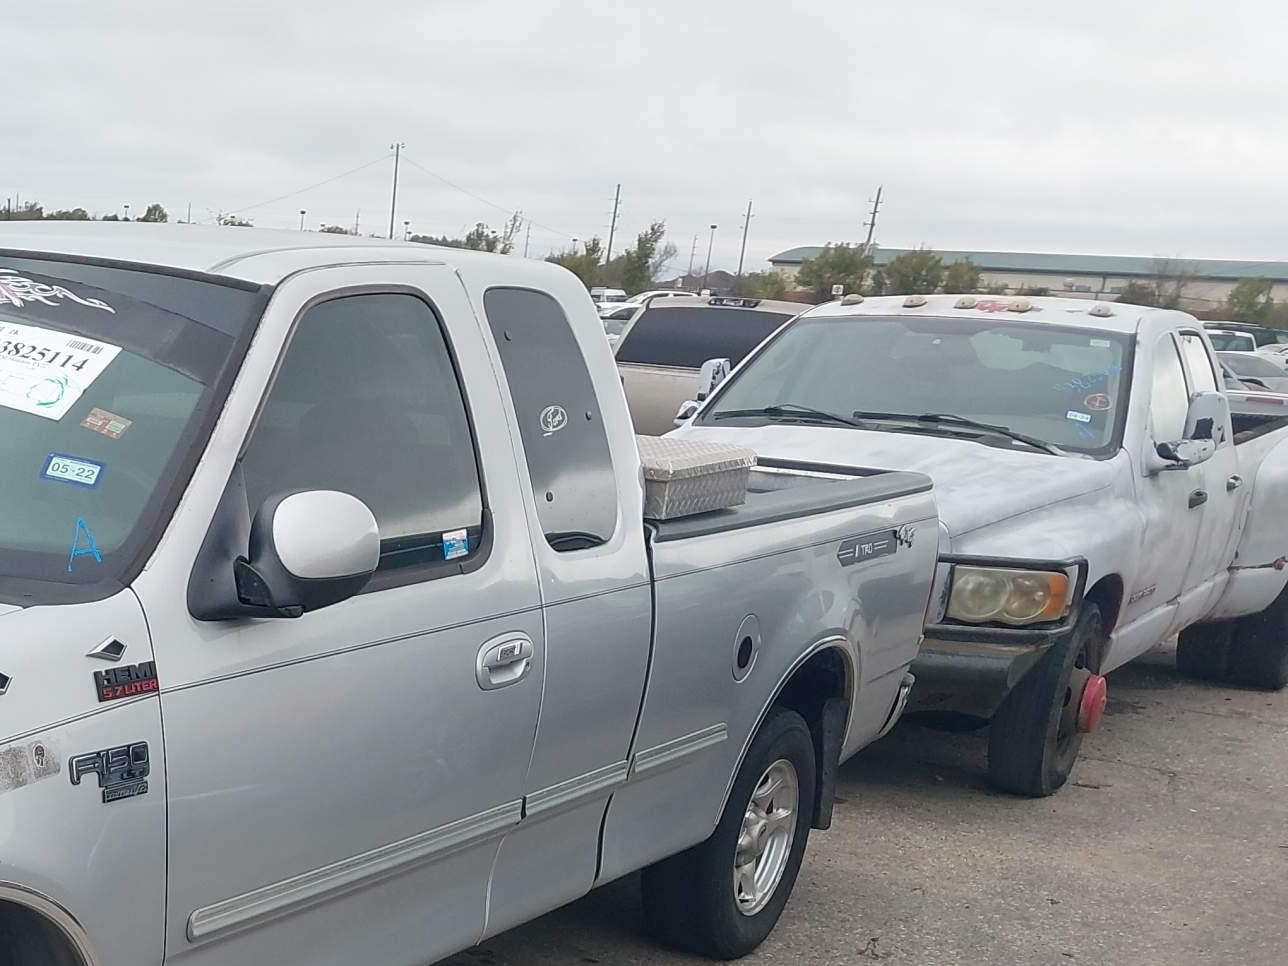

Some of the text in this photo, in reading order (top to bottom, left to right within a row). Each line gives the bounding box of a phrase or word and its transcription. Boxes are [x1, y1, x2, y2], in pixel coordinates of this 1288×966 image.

[67, 517, 103, 573] A
[93, 660, 157, 689] HEMI
[124, 679, 158, 695] LITER
